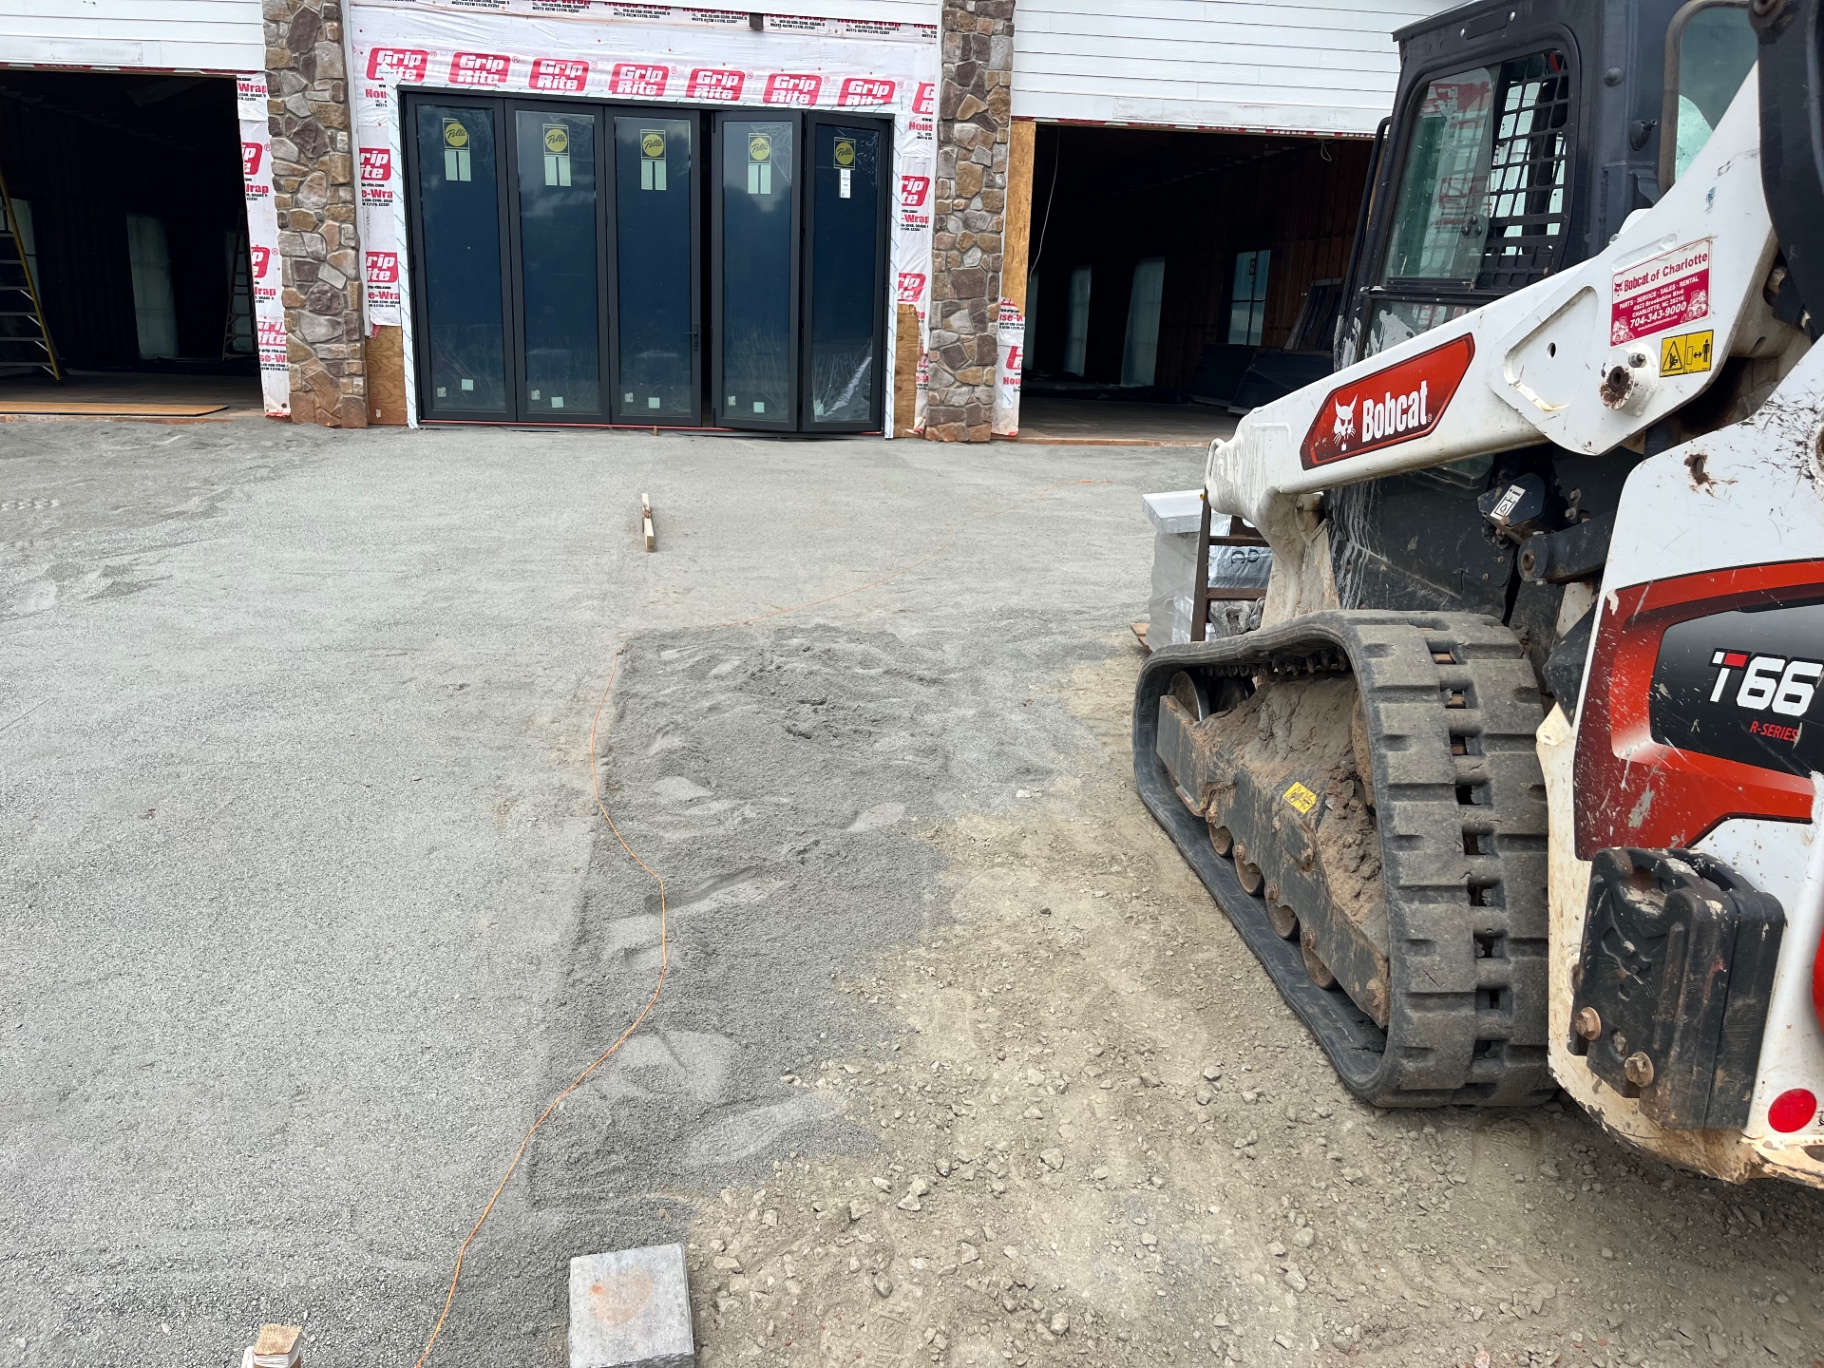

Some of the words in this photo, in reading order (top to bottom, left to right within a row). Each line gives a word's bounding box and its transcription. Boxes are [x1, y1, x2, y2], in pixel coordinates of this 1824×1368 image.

[460, 55, 504, 72] Grip
[540, 60, 582, 78] Grip
[457, 70, 499, 84] Rite
[620, 66, 663, 82] Grip
[696, 70, 739, 88] Grip
[537, 75, 578, 90] Rite
[617, 80, 658, 95] Rite
[773, 76, 816, 92] Grip
[848, 80, 890, 97] Grip
[693, 85, 734, 100] Rite
[770, 90, 810, 105] Rite
[446, 128, 467, 139] Pella
[547, 133, 566, 144] Pella
[642, 136, 663, 149] Pella
[751, 141, 769, 153] Pella
[360, 151, 389, 166] rip
[360, 165, 383, 178] ite
[367, 254, 395, 269] rip
[368, 268, 391, 280] ite
[1624, 273, 1650, 292] Bobcat
[1650, 270, 1660, 281] of
[1662, 253, 1707, 277] Charlotte
[1620, 300, 1634, 309] PARTS
[1636, 292, 1657, 303] SERVICE
[1660, 284, 1676, 294] SALES
[1679, 276, 1699, 287] RENTAL
[1630, 302, 1687, 328] 704-343-9000
[1362, 380, 1428, 443] Bobcat
[1750, 721, 1800, 742] R-SERIES
